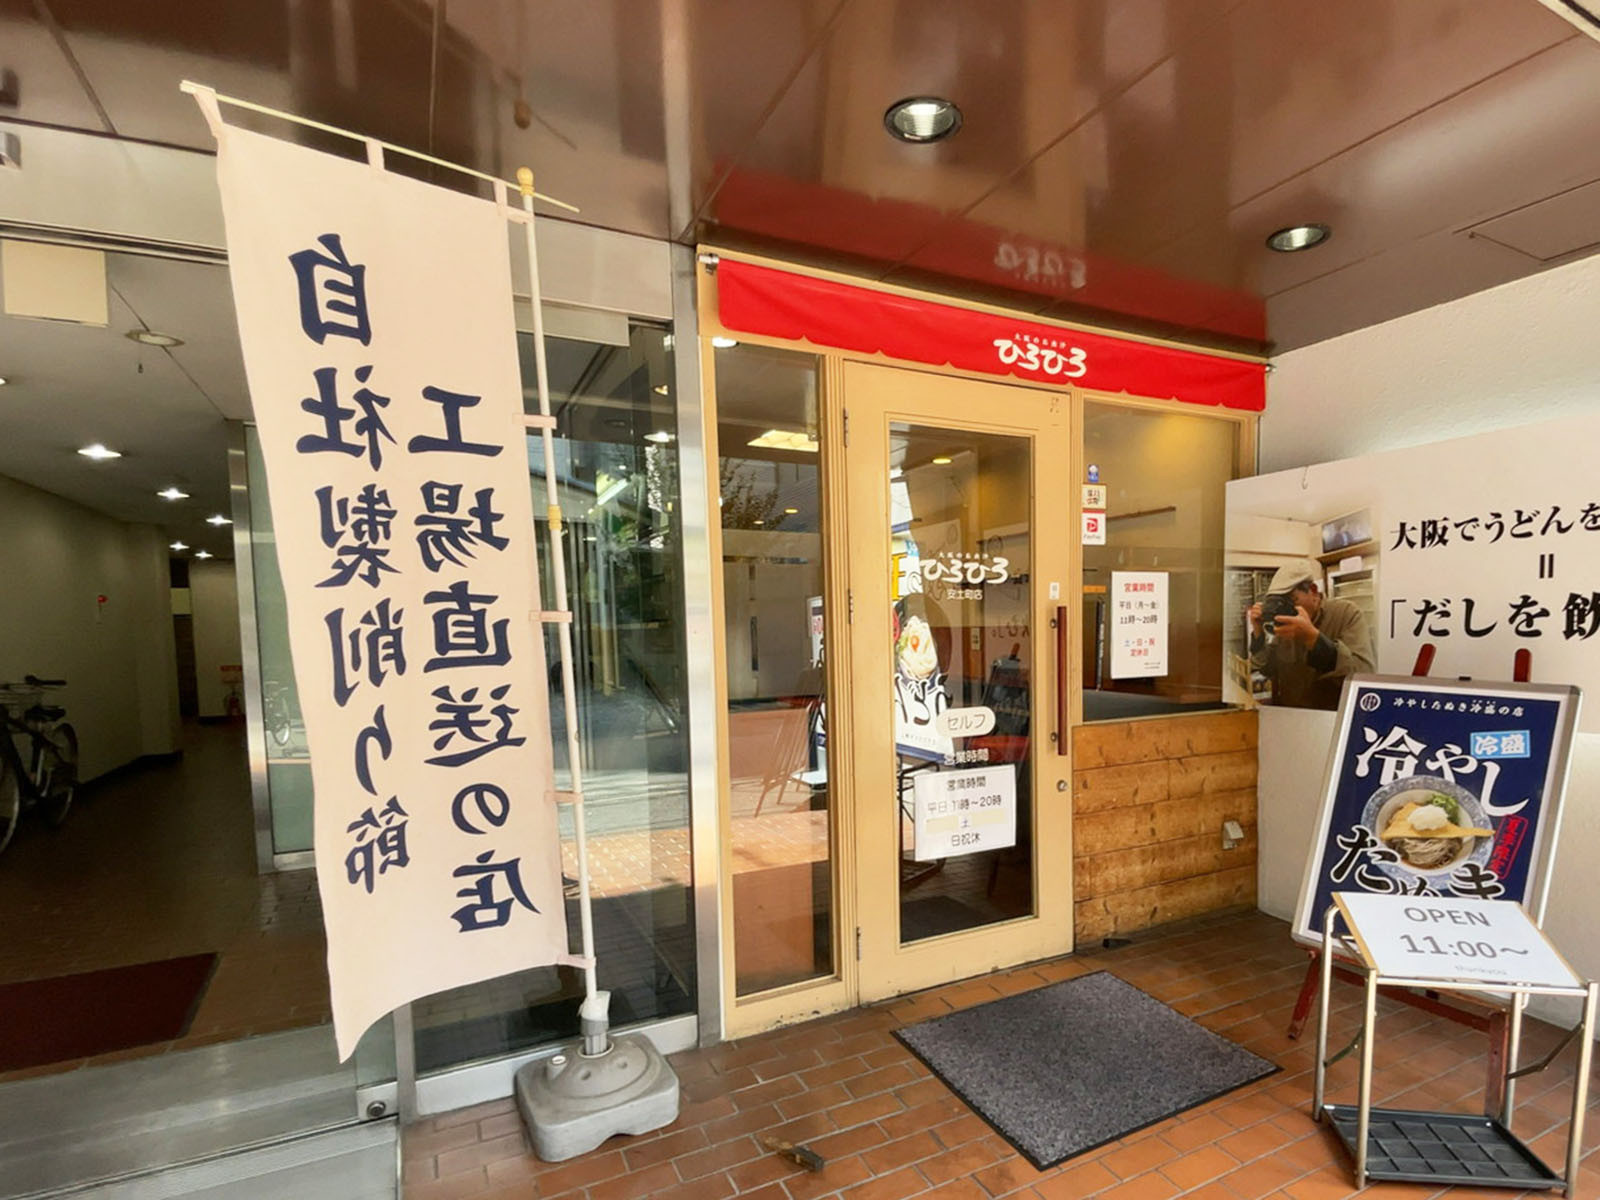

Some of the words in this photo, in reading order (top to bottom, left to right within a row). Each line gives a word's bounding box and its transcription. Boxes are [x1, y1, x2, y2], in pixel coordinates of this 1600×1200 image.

[993, 338, 1087, 378] ひろひろ
[1389, 503, 1600, 551] 大阪でうどんを
[919, 557, 1009, 585] ひろひろ
[1123, 583, 1156, 593] 営業時間
[1390, 592, 1600, 641] 「だしを飲
[946, 713, 987, 731] セルフ
[1474, 734, 1526, 756] 冷盛
[1355, 725, 1530, 817] 冷やし
[946, 776, 987, 791] 営業時間
[951, 833, 981, 847] 日祝休
[1404, 906, 1491, 927] OPEN
